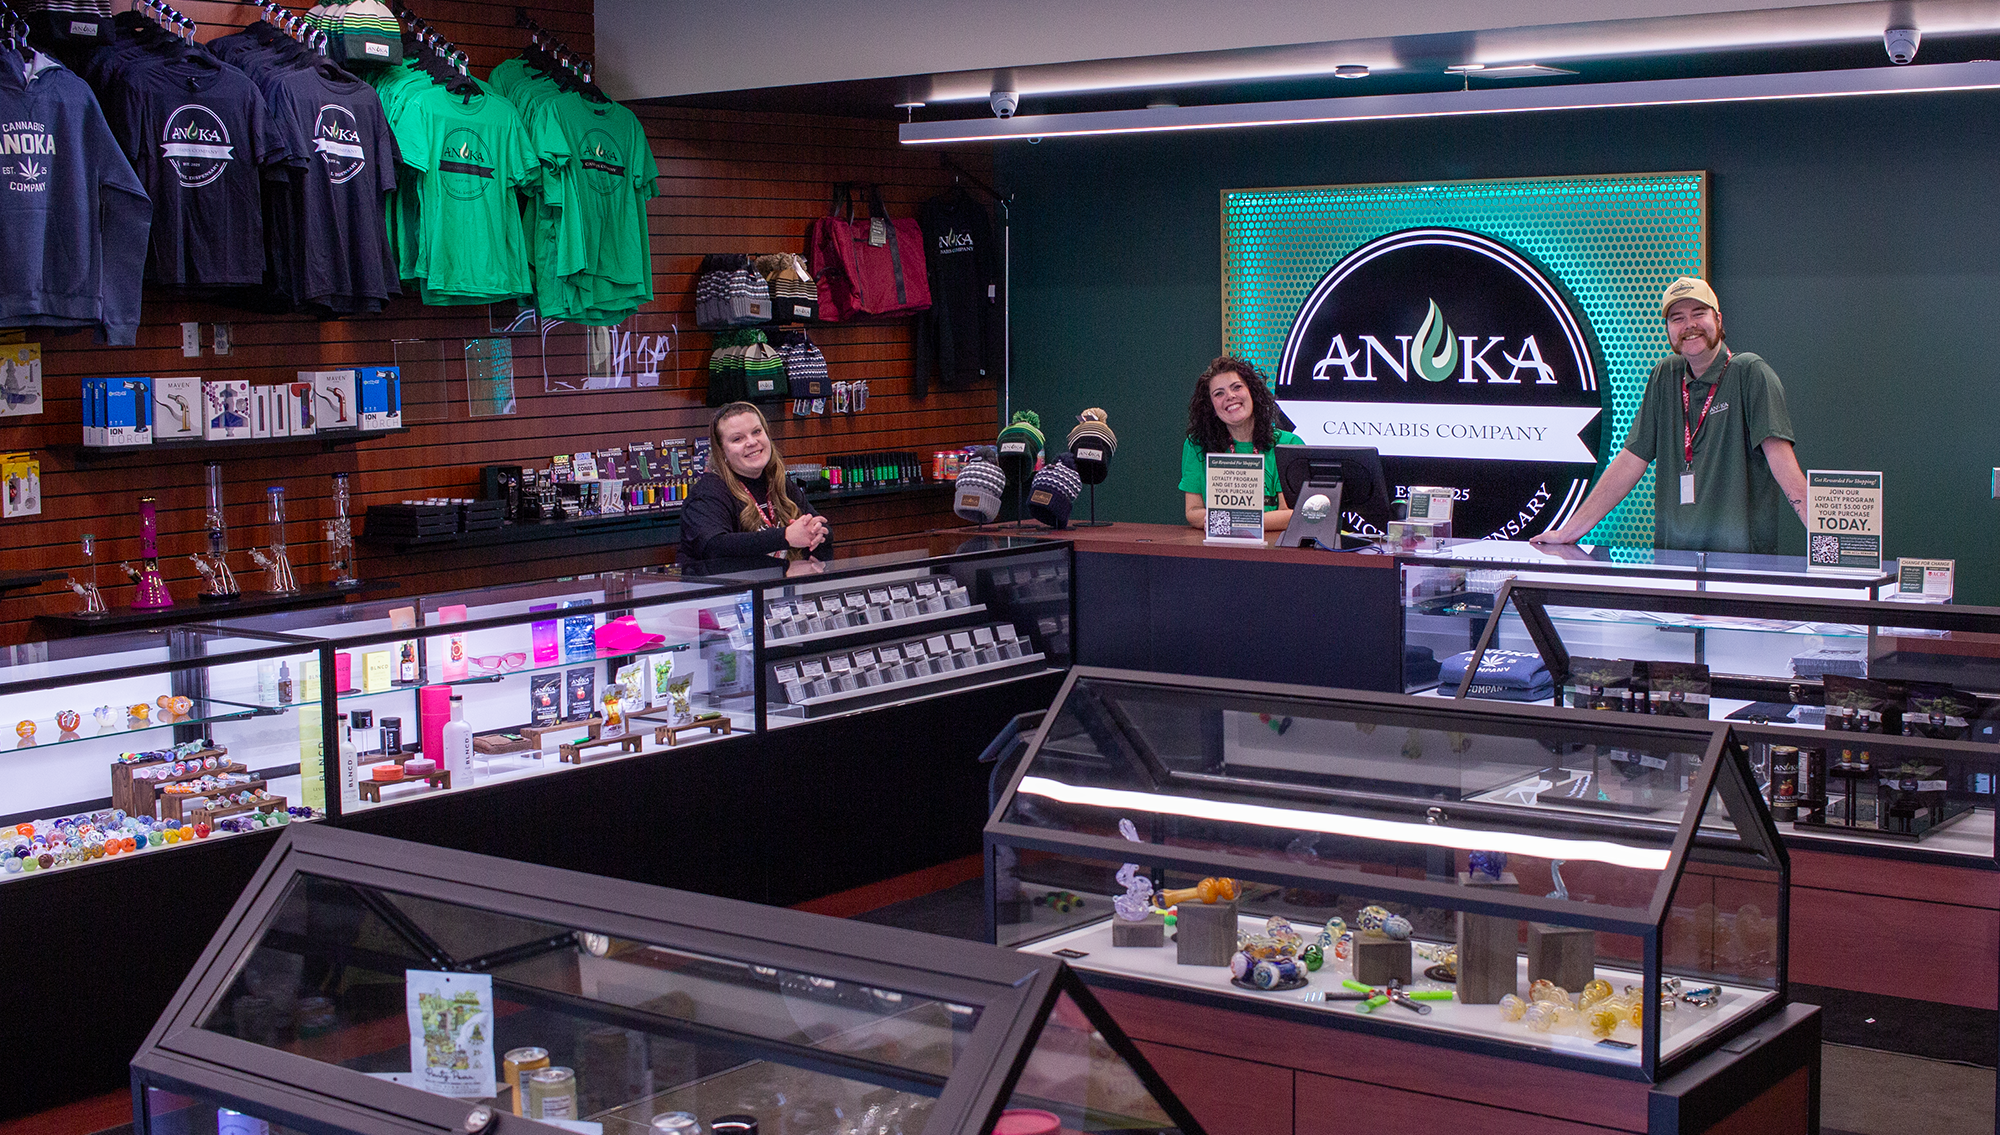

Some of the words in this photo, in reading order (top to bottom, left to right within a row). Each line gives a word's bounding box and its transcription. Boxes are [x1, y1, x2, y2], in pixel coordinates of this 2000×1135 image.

[2, 121, 45, 132] CANNABIS
[322, 122, 360, 143] NOKA
[2, 166, 16, 174] EST.
[41, 166, 47, 174] 25
[10, 181, 46, 192] COMPANY
[365, 418, 399, 428] TORCH
[1322, 420, 1430, 437] CANNABIS
[1436, 424, 1548, 441] COMPANY
[110, 434, 149, 444] TORCH
[1854, 478, 1877, 486] Shopping!
[1214, 495, 1255, 506] TODAY.
[1818, 517, 1871, 531] TODAY.
